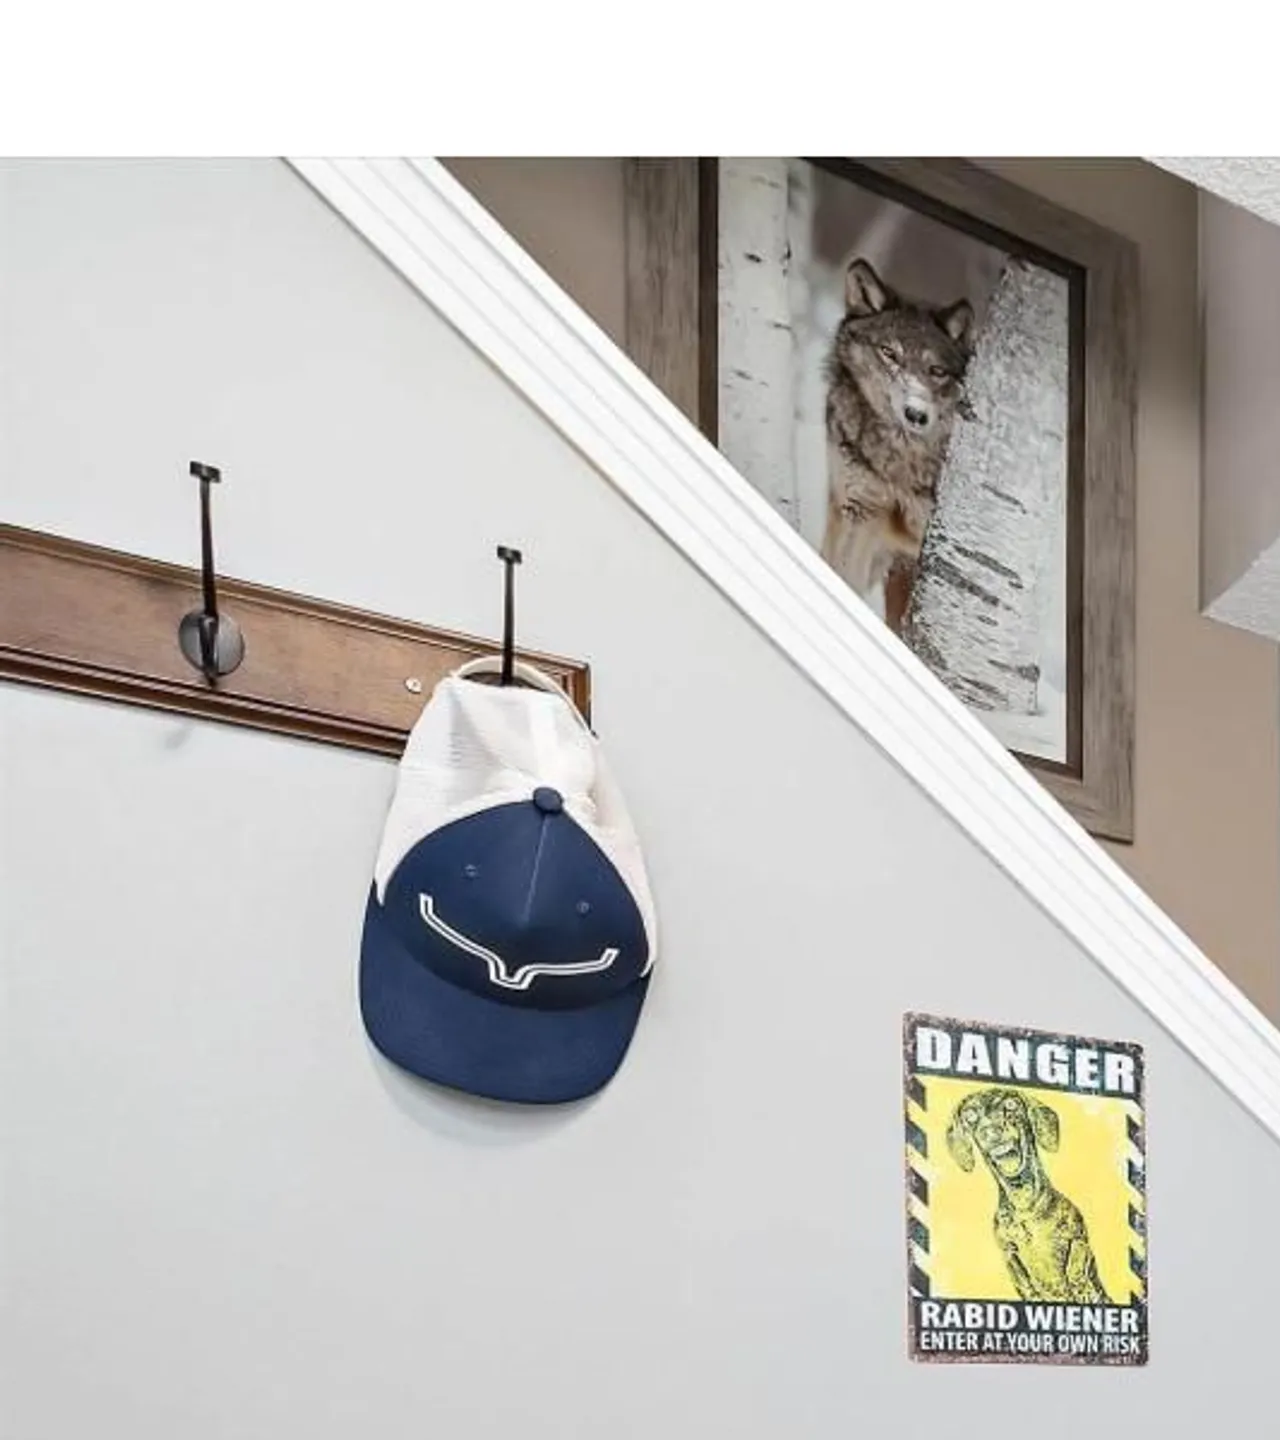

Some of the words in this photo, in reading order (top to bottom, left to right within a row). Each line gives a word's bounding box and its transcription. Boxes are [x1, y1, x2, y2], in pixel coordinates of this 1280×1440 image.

[914, 1026, 1136, 1094] DANGER
[920, 1301, 1018, 1330] RABID
[1024, 1305, 1139, 1334] WIENER
[920, 1331, 977, 1351] ENTER
[981, 1332, 1005, 1352] AT
[1006, 1332, 1054, 1353] YOUR
[1057, 1333, 1099, 1354] OWN
[1103, 1334, 1141, 1355] RISK
